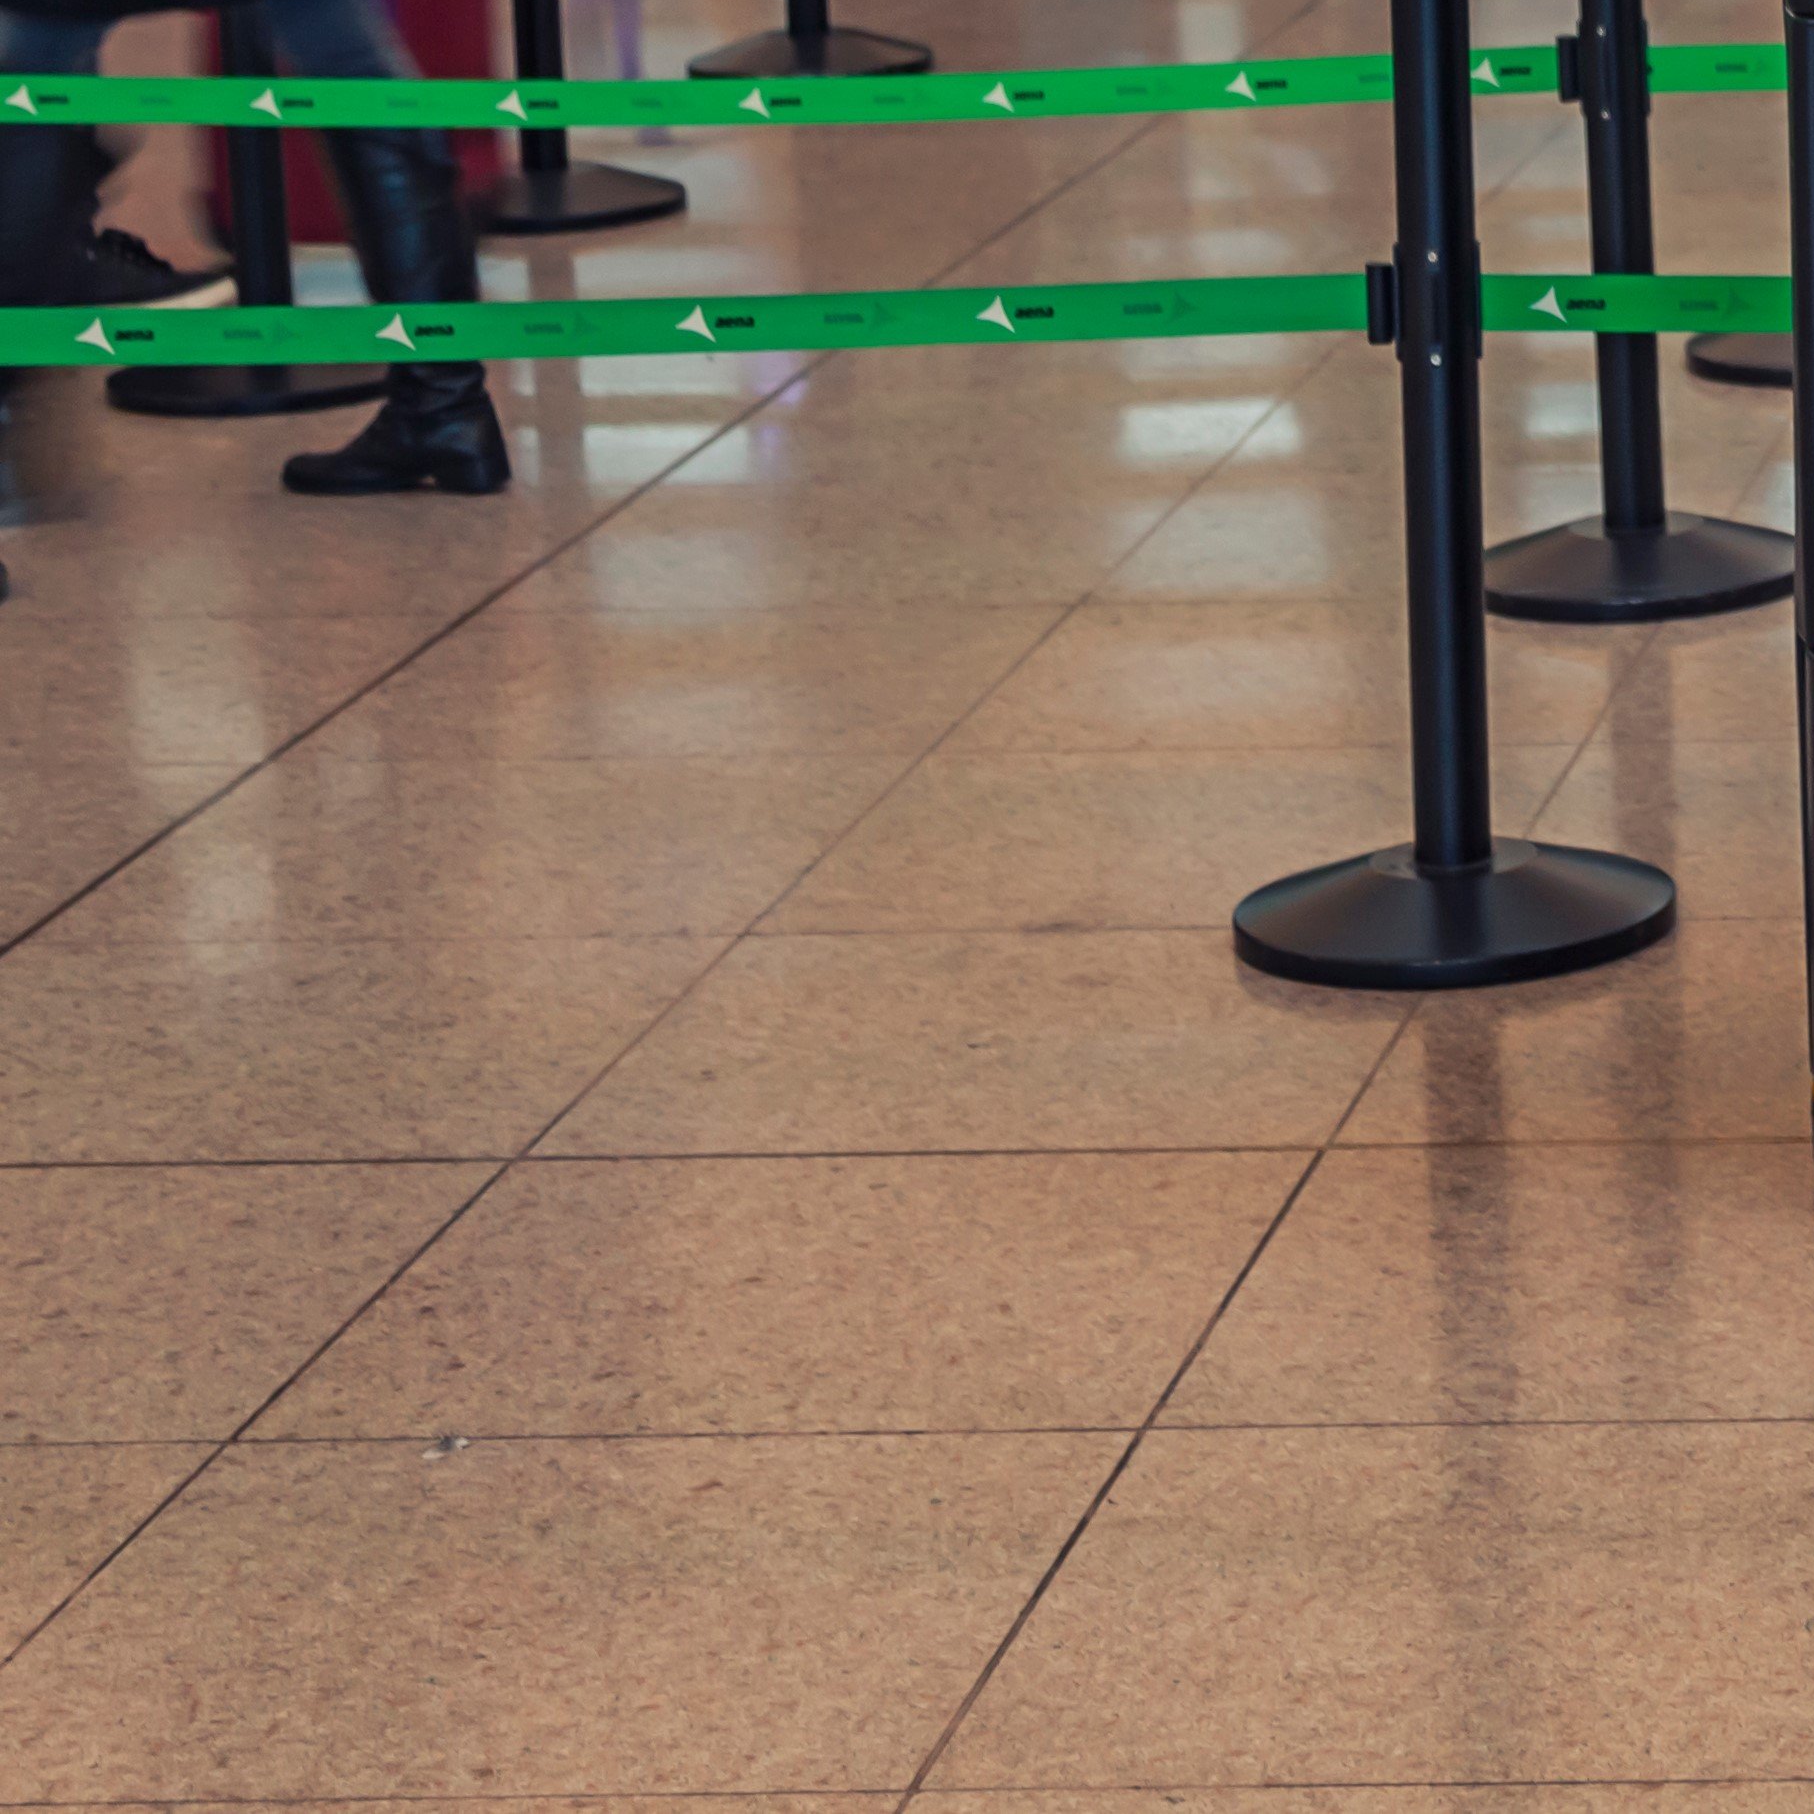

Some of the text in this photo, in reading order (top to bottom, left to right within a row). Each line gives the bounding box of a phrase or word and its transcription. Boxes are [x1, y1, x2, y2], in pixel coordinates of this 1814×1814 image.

[1565, 298, 1606, 311] aena
[1014, 306, 1055, 320] aena
[714, 316, 755, 329] aena
[114, 329, 155, 342] aena
[414, 324, 455, 337] aena
